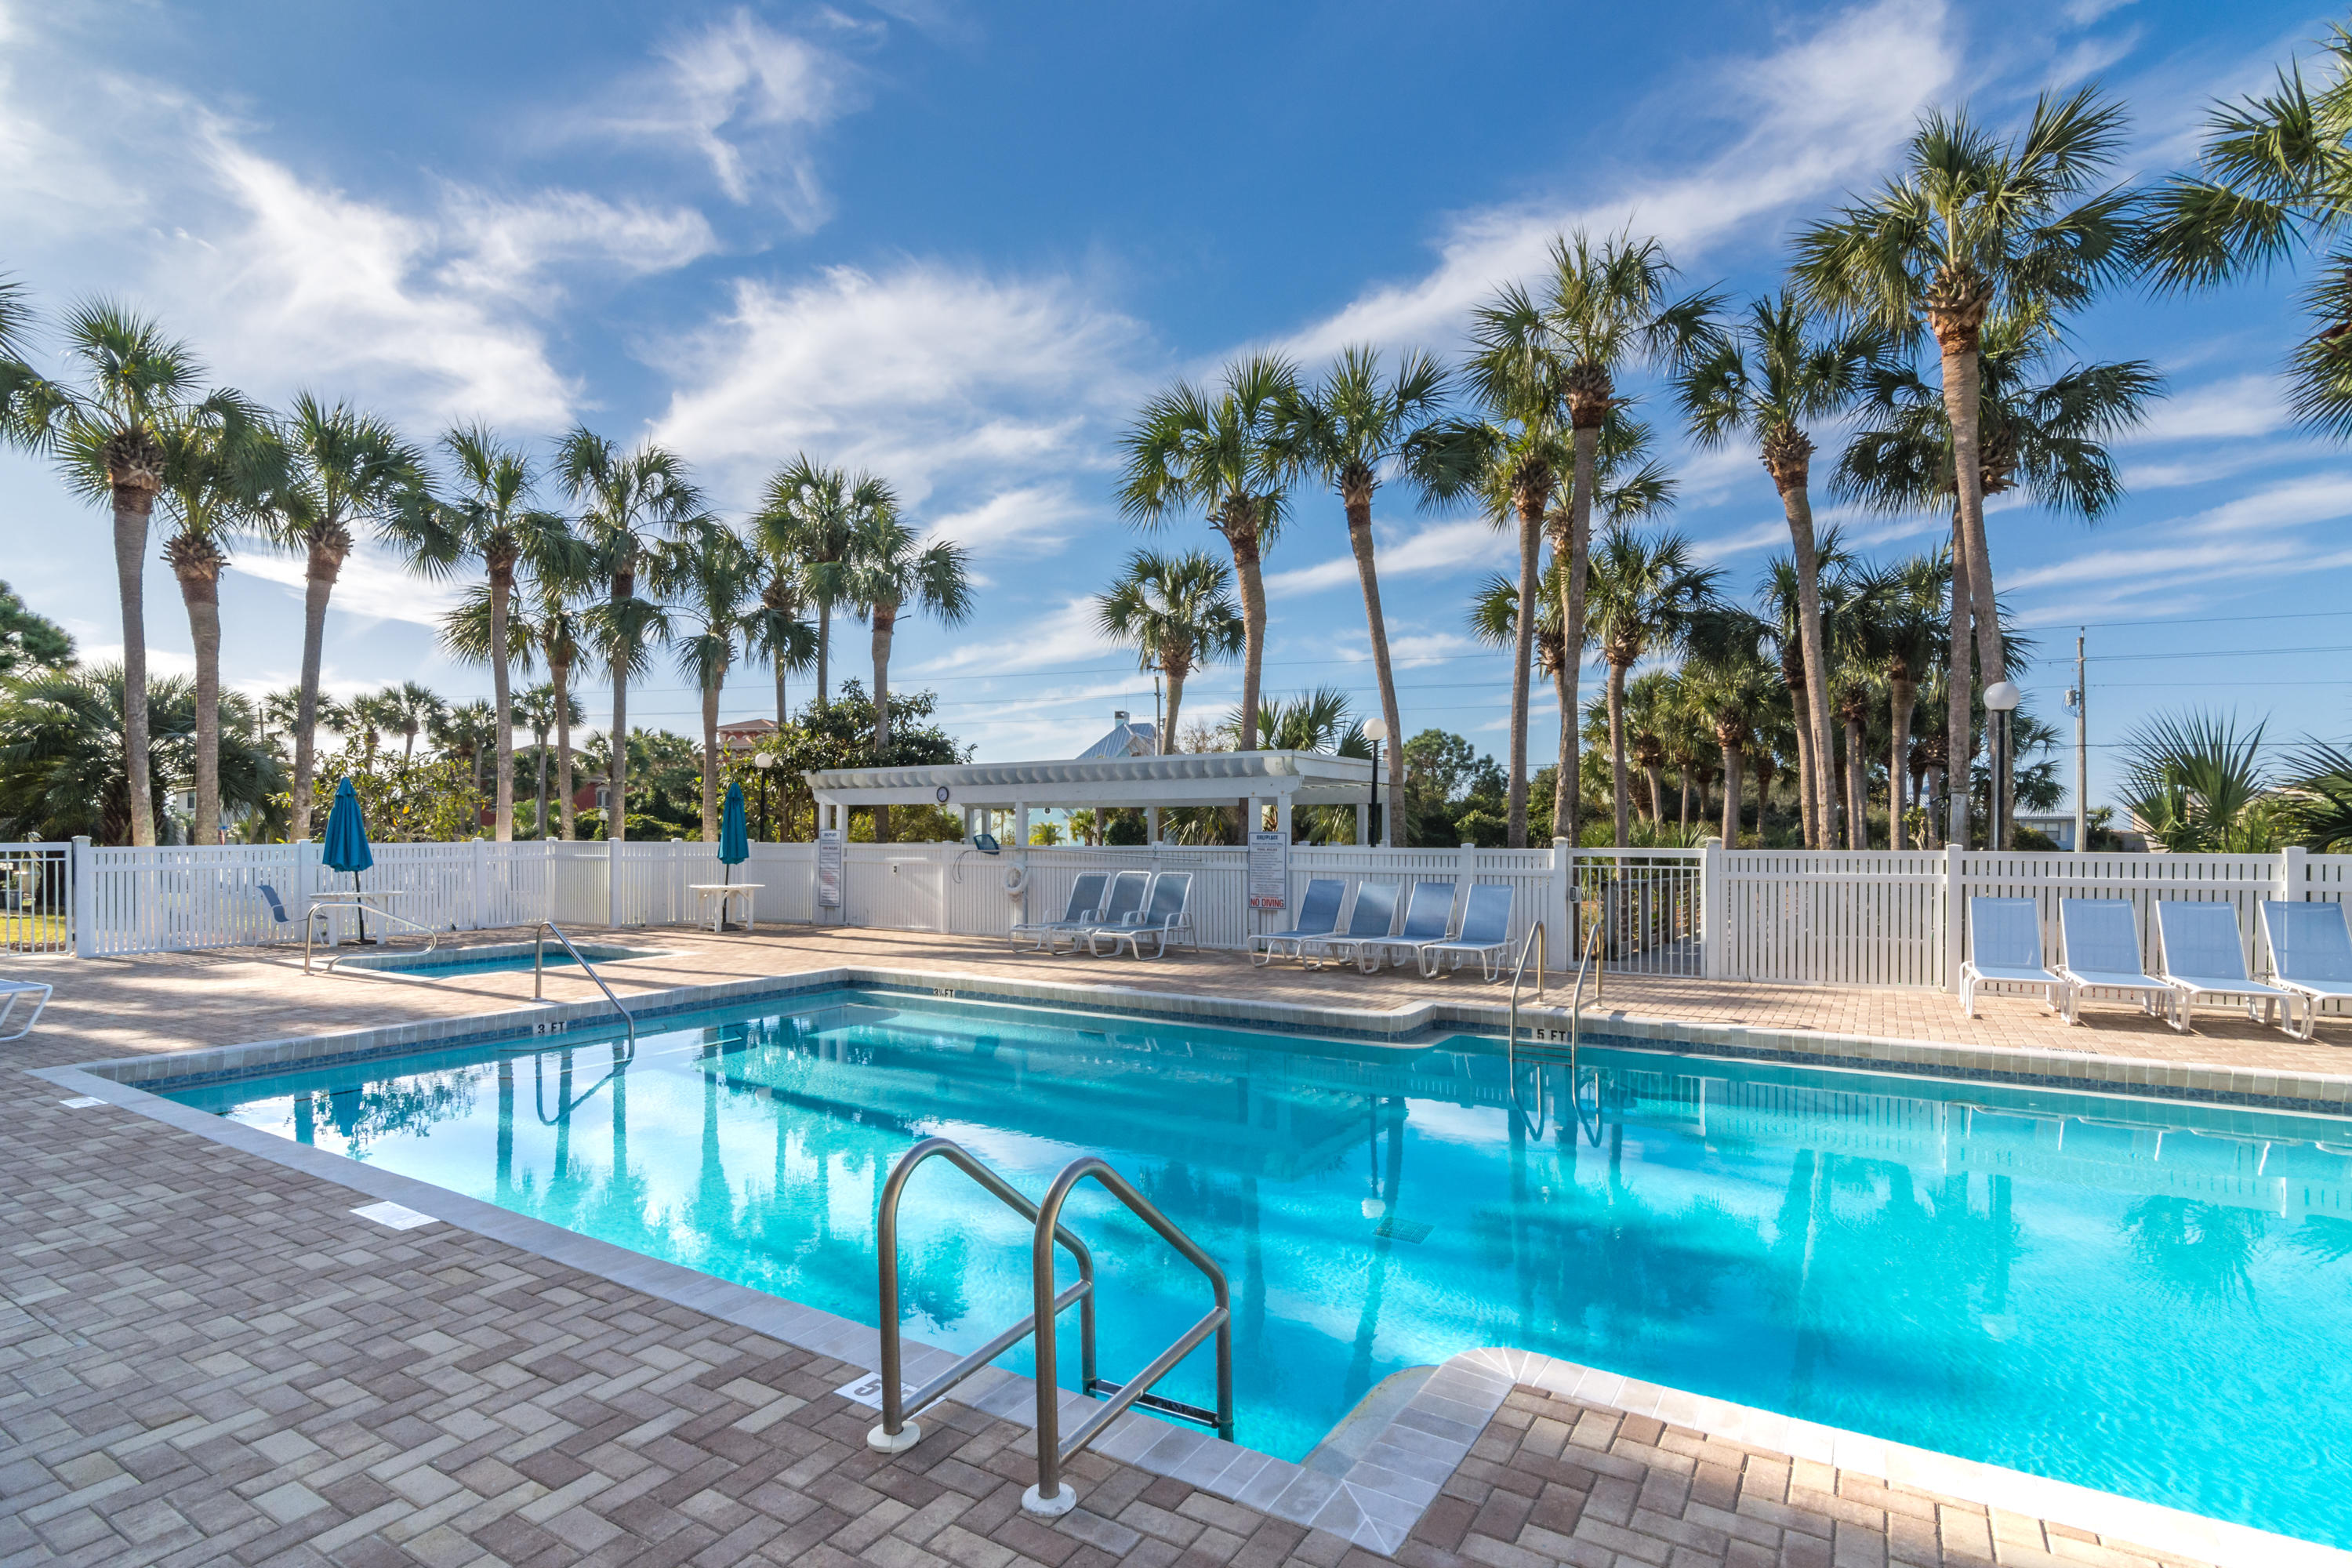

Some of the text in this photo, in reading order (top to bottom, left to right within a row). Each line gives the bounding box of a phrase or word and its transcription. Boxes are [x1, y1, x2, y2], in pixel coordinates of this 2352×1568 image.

[1250, 898, 1284, 908] NO DIVING
[538, 1022, 564, 1033] 3 FT
[1537, 1029, 1566, 1041] 5 FT
